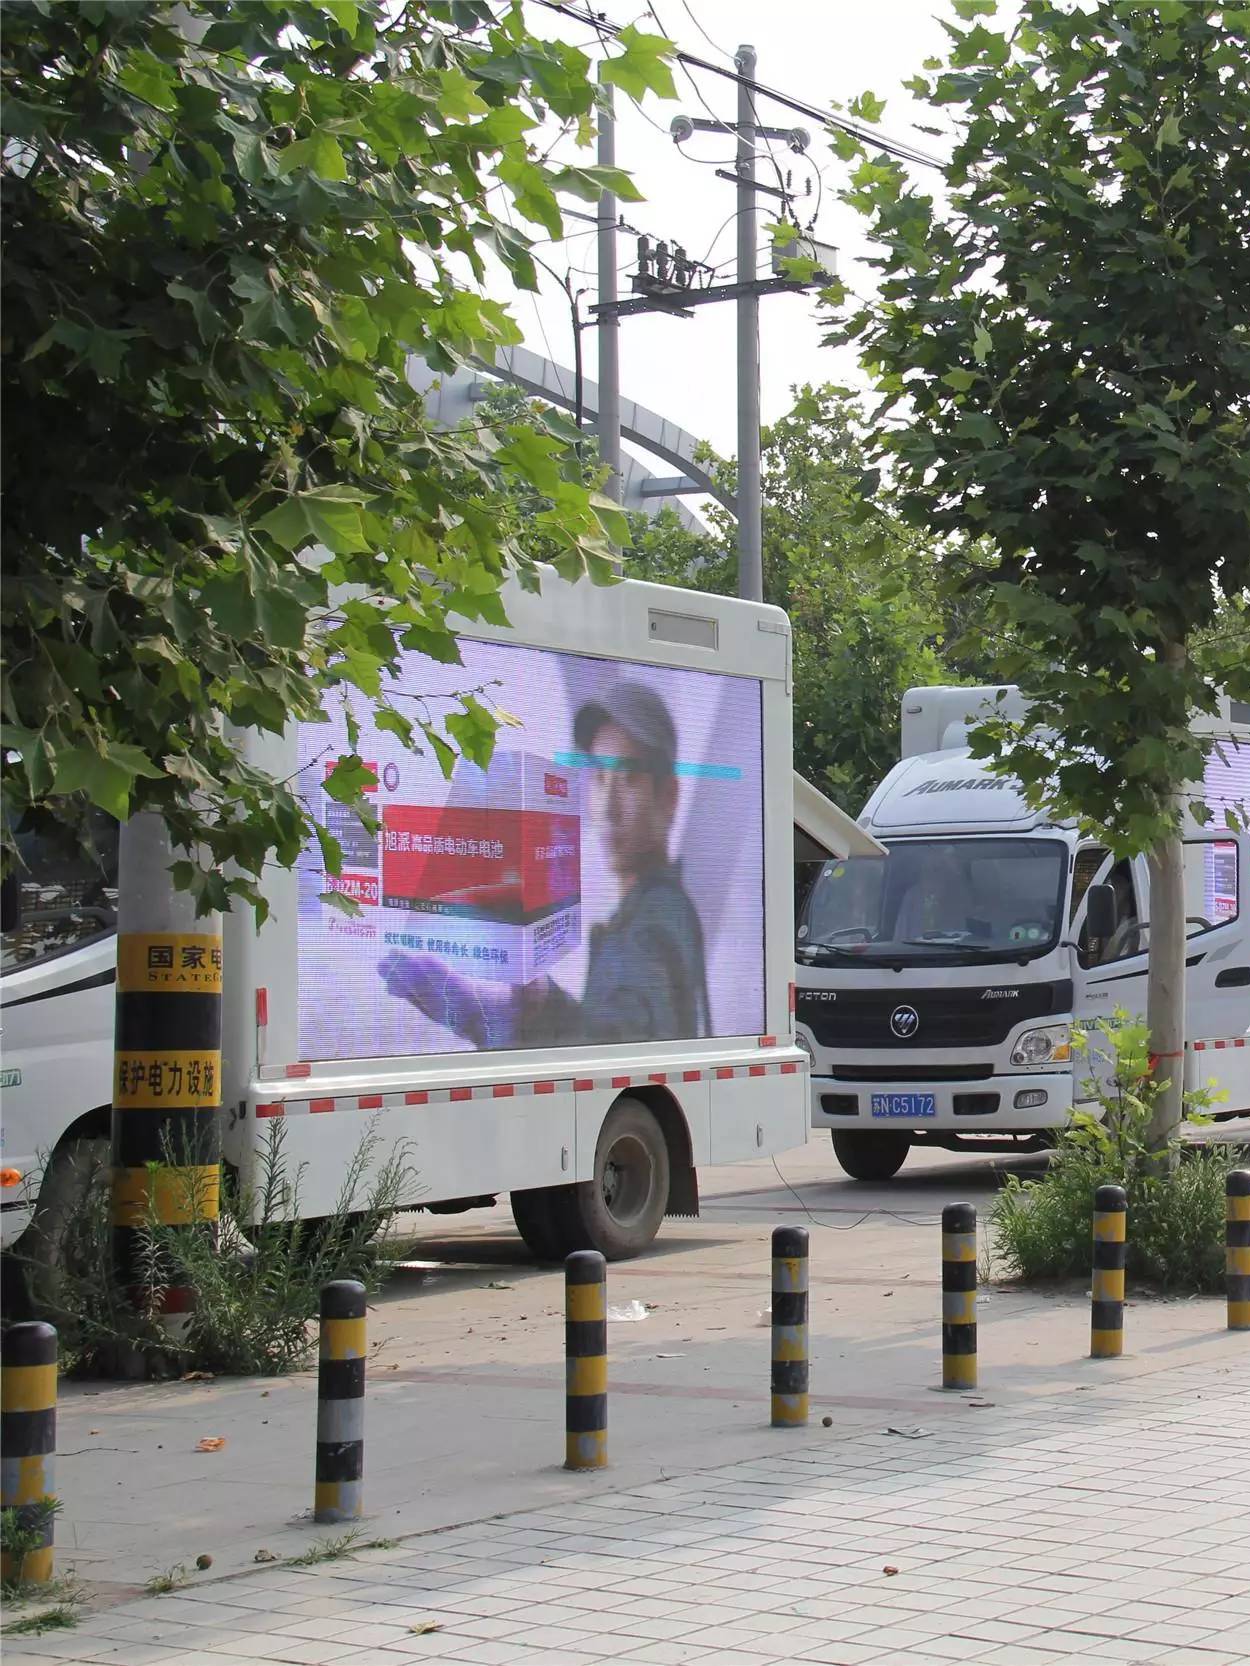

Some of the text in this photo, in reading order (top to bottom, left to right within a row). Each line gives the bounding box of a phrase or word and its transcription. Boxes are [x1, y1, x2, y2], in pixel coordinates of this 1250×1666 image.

[119, 1060, 214, 1096] 保护电力设施
